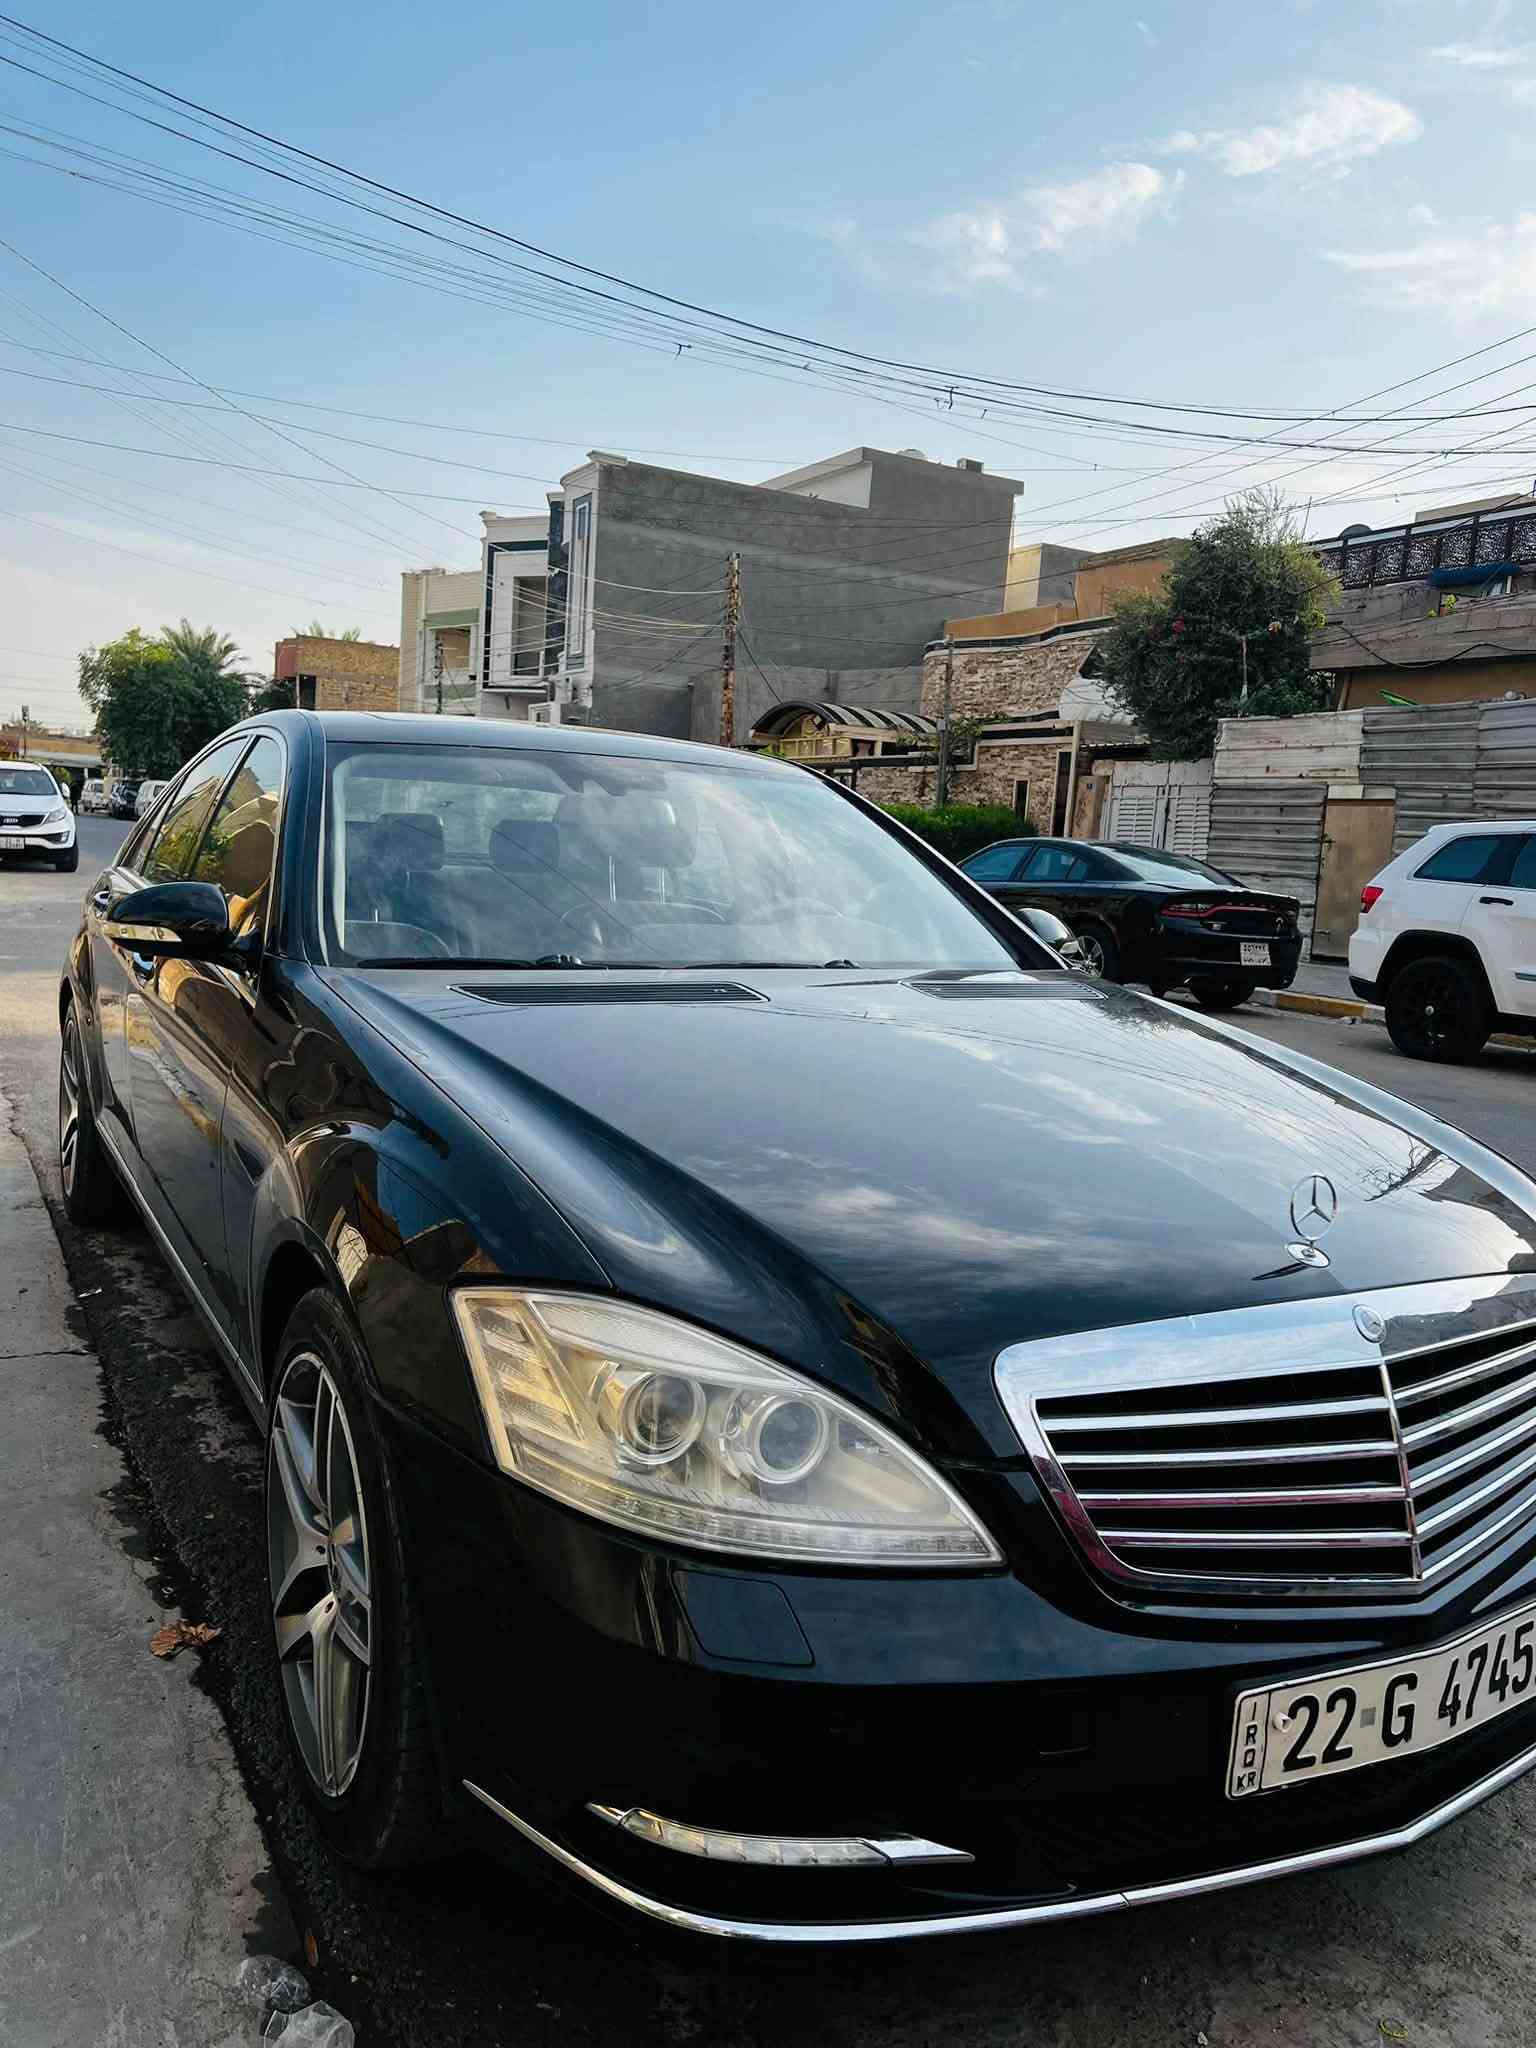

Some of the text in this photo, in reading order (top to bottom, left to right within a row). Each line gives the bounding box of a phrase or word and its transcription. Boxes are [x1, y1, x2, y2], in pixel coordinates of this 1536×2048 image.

[1282, 1620, 1536, 1773] 22 G 4745
[1235, 1771, 1257, 1792] KR
